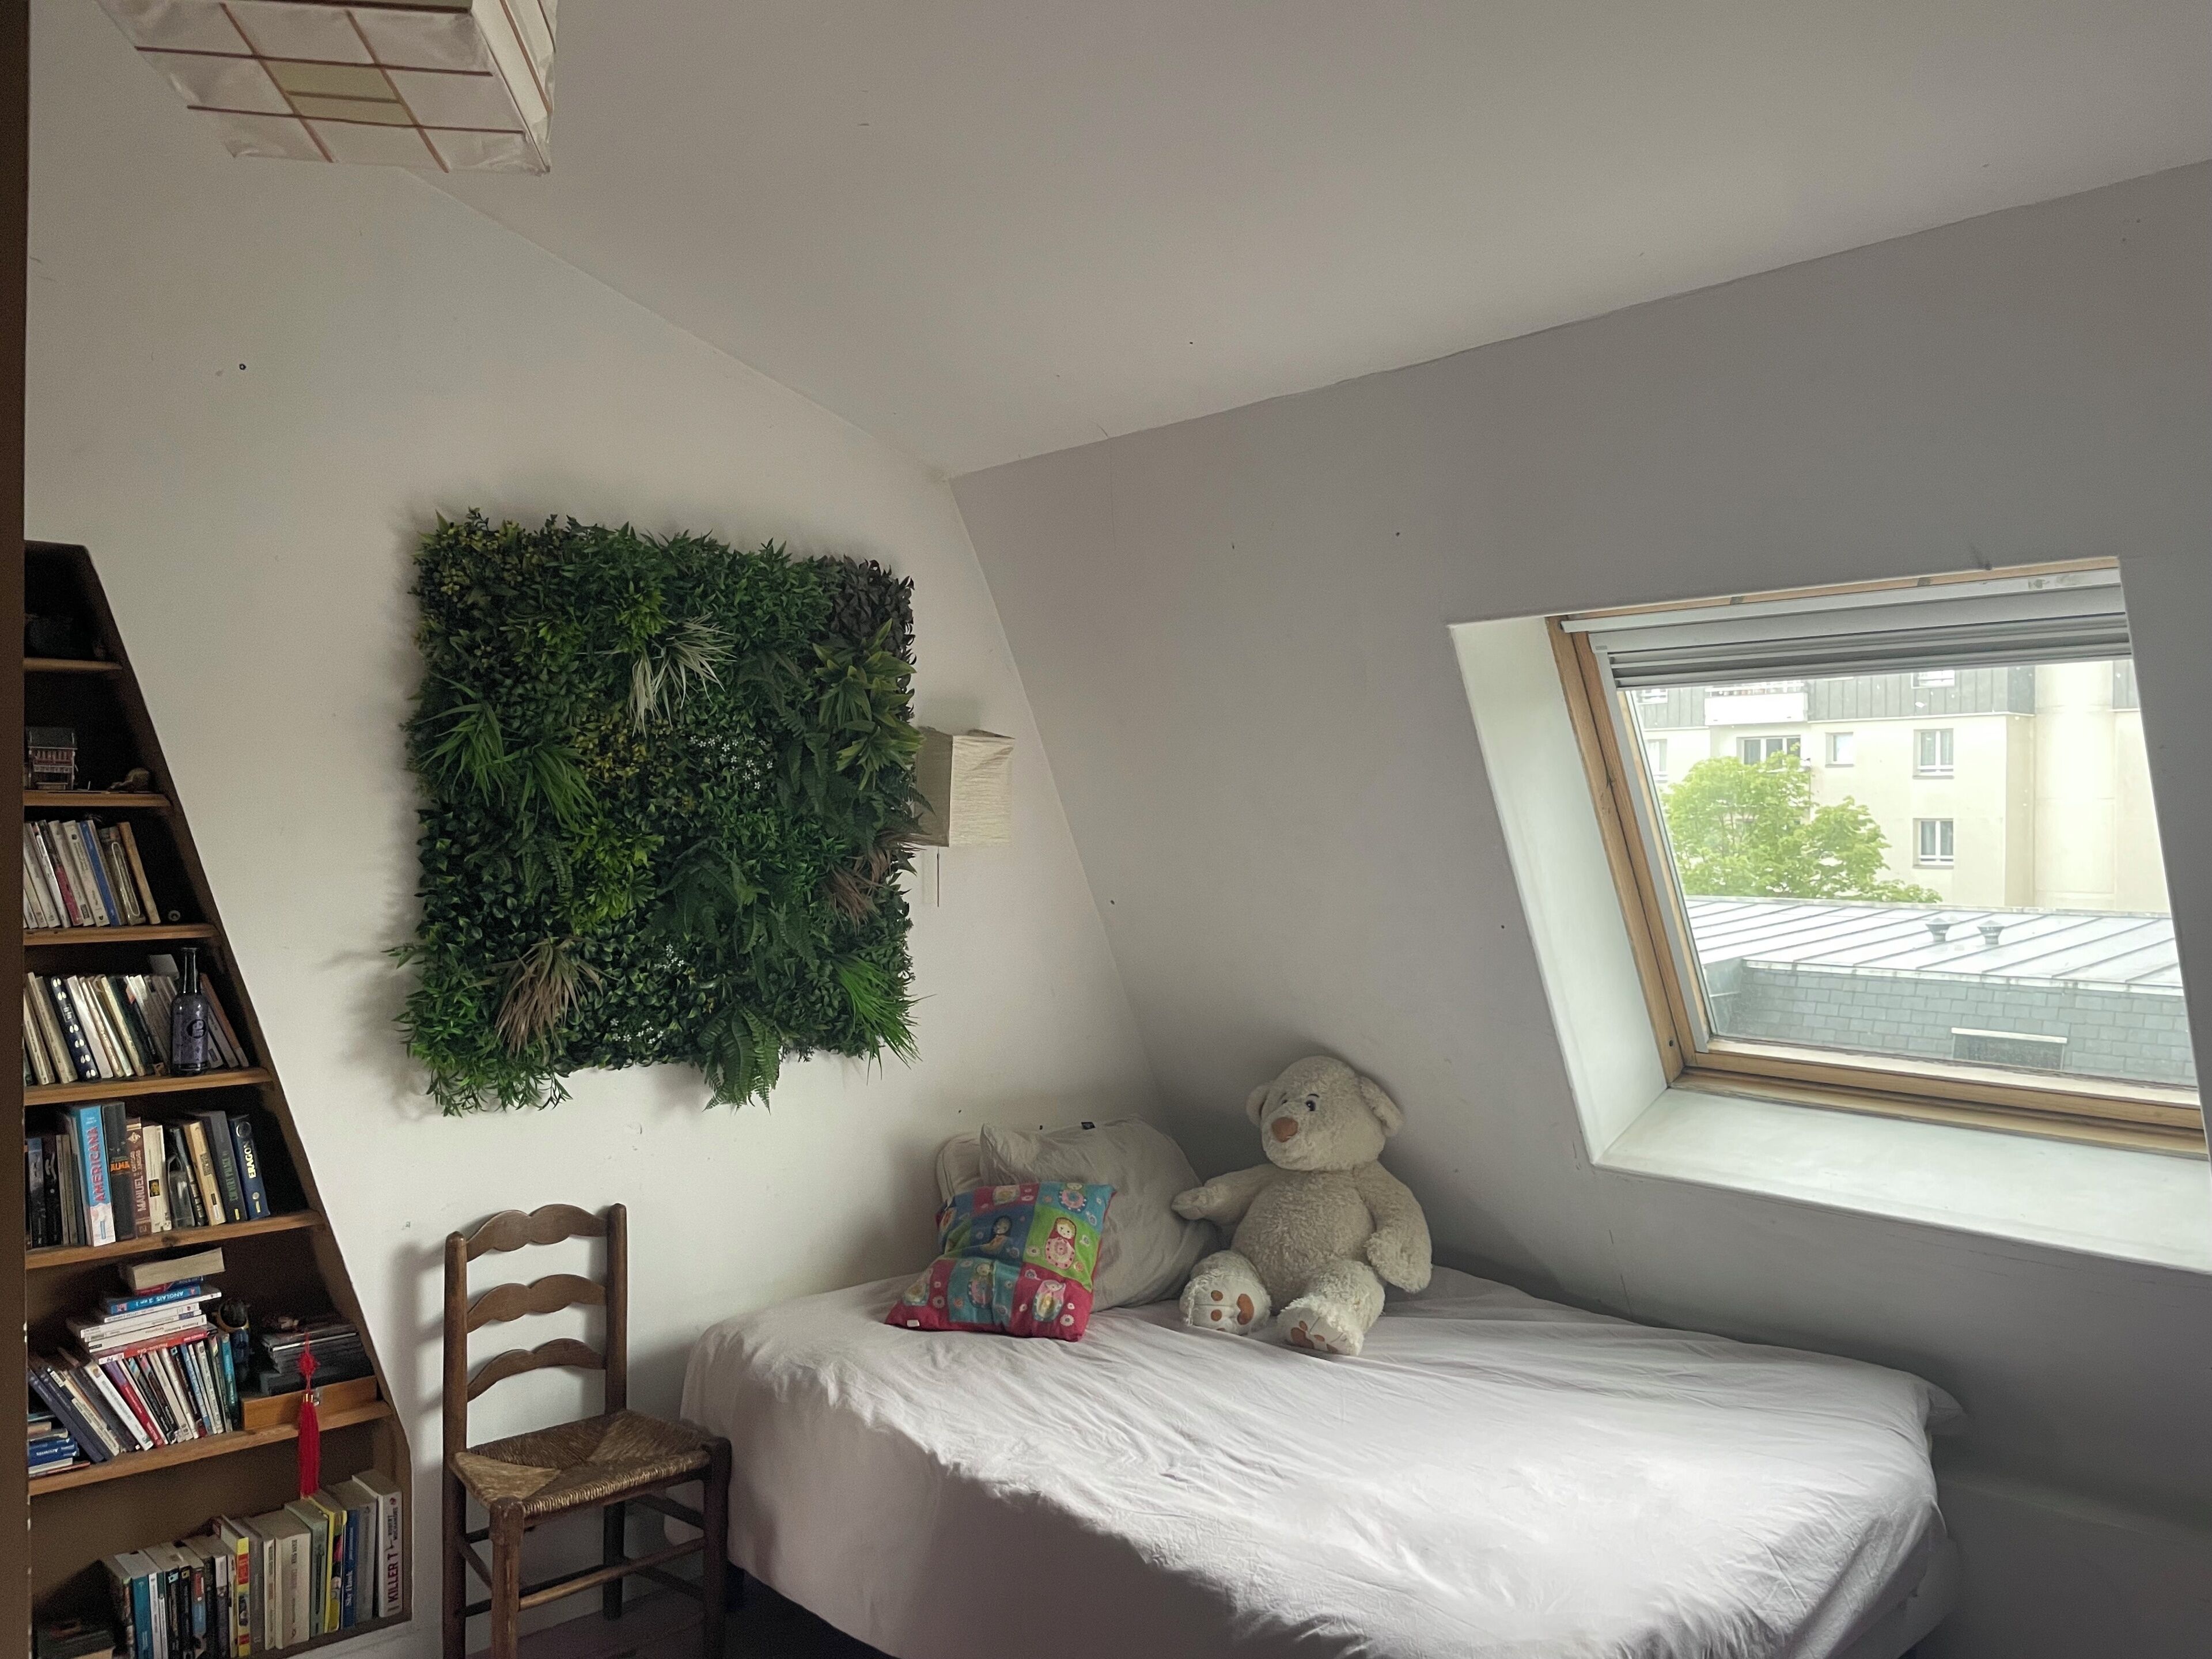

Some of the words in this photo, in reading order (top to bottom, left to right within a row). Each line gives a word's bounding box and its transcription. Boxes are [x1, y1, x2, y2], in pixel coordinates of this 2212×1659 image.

[88, 1127, 105, 1202] AMERICANA
[244, 1142, 256, 1179] ERAGON
[135, 1176, 146, 1212] MANUEL
[157, 1291, 184, 1302] ANGLAIS
[388, 1563, 399, 1603] KILLER
